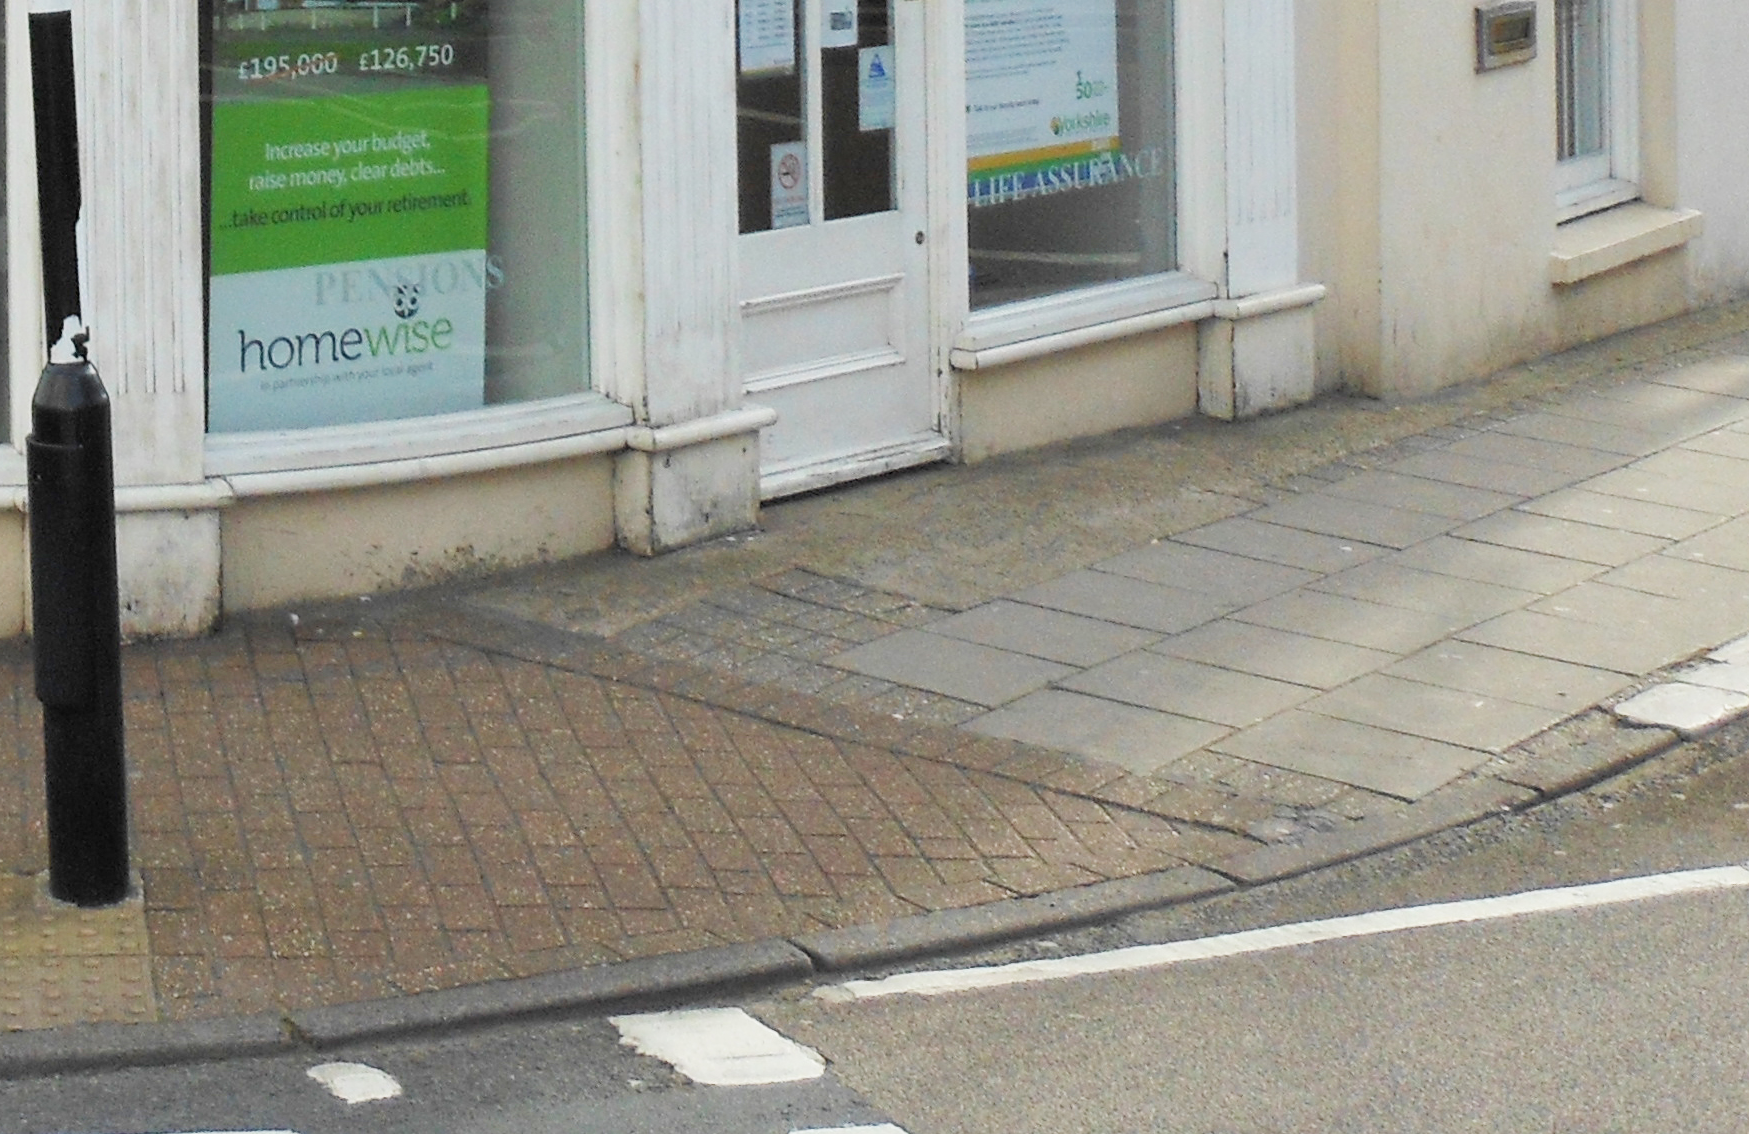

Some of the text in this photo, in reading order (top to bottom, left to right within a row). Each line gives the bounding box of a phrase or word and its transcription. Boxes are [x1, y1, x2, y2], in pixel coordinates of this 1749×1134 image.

[237, 43, 455, 81] £195,000 £126,750
[265, 140, 331, 162] Increase
[332, 136, 370, 162] your
[249, 171, 286, 192] raise
[350, 160, 388, 183] clear
[973, 144, 1165, 208] LIFE ASSURANCE
[271, 200, 327, 224] control
[329, 198, 347, 219] of
[349, 198, 383, 223] your
[237, 316, 455, 373] homewise
